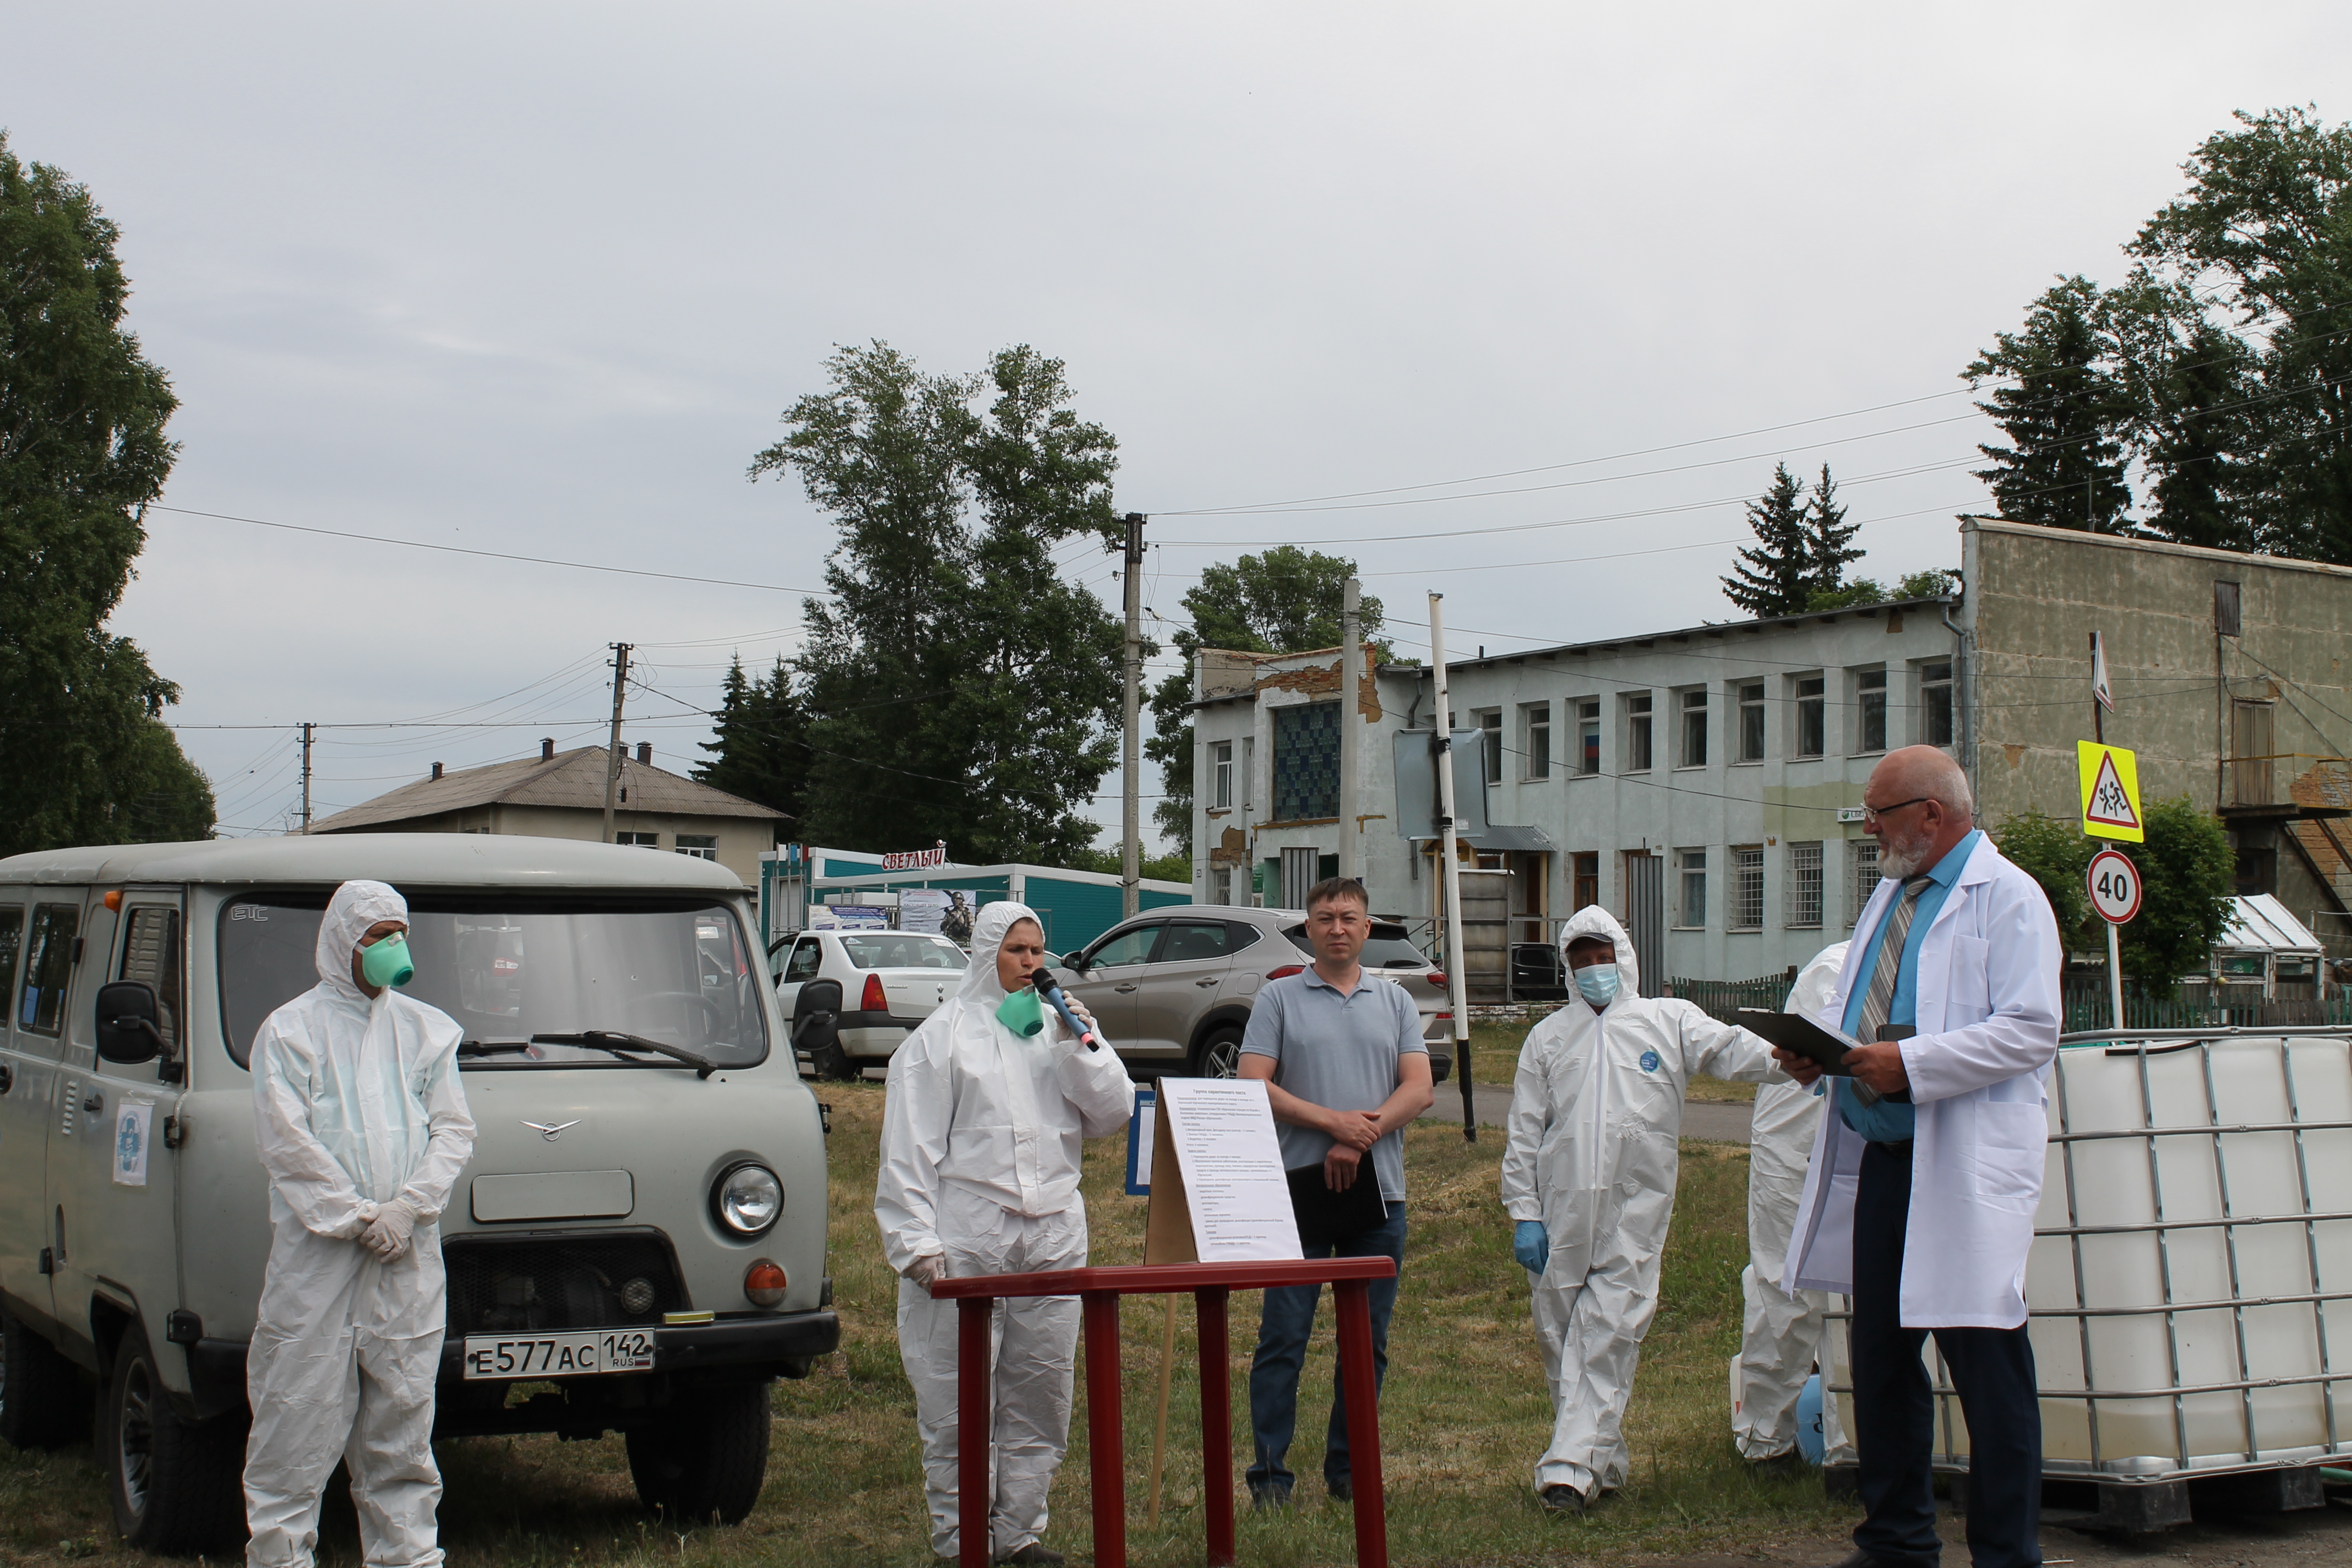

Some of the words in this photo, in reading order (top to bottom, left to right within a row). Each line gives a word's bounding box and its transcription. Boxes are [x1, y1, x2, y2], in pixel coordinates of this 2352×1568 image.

[2097, 872, 2127, 902] 40
[231, 905, 268, 921] ETC
[603, 1333, 646, 1358] 142
[613, 1357, 634, 1367] RUS
